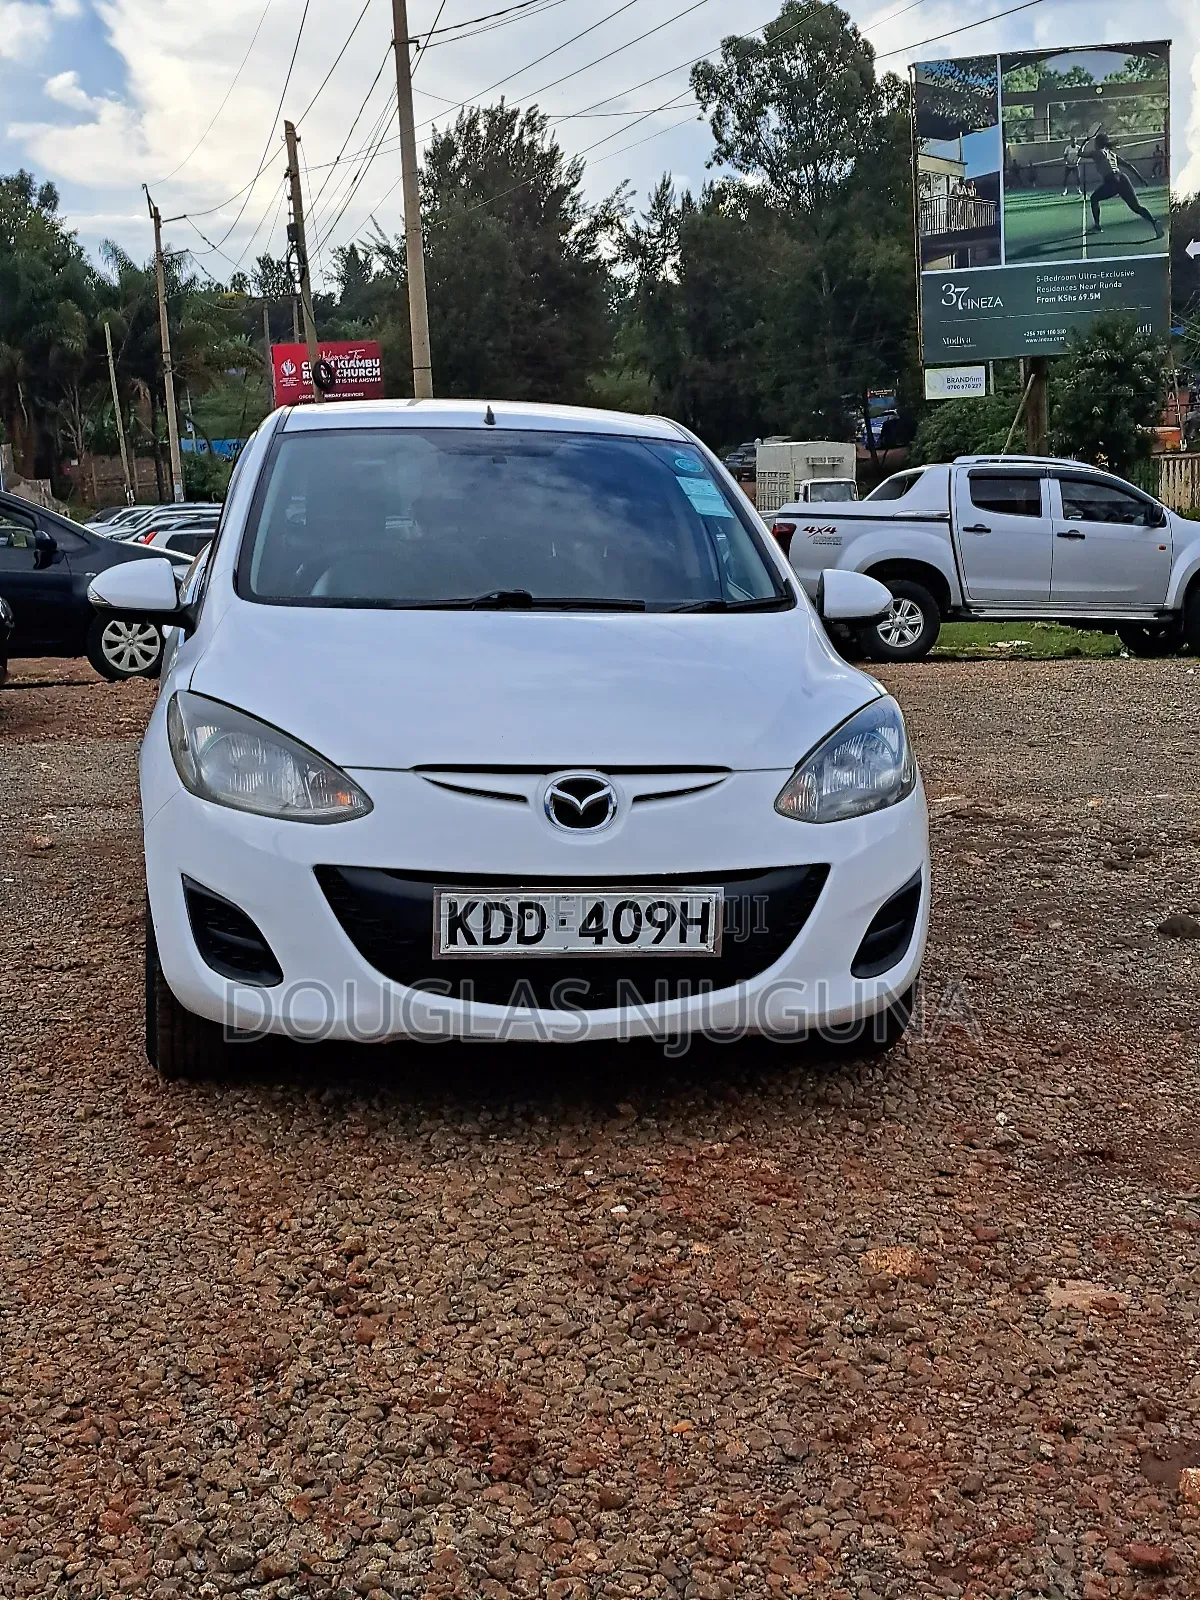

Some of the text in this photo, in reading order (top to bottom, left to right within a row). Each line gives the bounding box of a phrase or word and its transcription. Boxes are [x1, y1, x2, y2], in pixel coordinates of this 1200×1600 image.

[1078, 269, 1135, 280] Ultra-Exclusive
[1036, 281, 1122, 293] Residences Near Runda
[941, 282, 1004, 310] 37 INEZA
[1036, 295, 1056, 304] From
[1078, 292, 1101, 301] 69.5M
[337, 358, 380, 369] KIAMBU
[336, 368, 381, 378] CHURCH
[448, 899, 713, 946] KDD 409H
